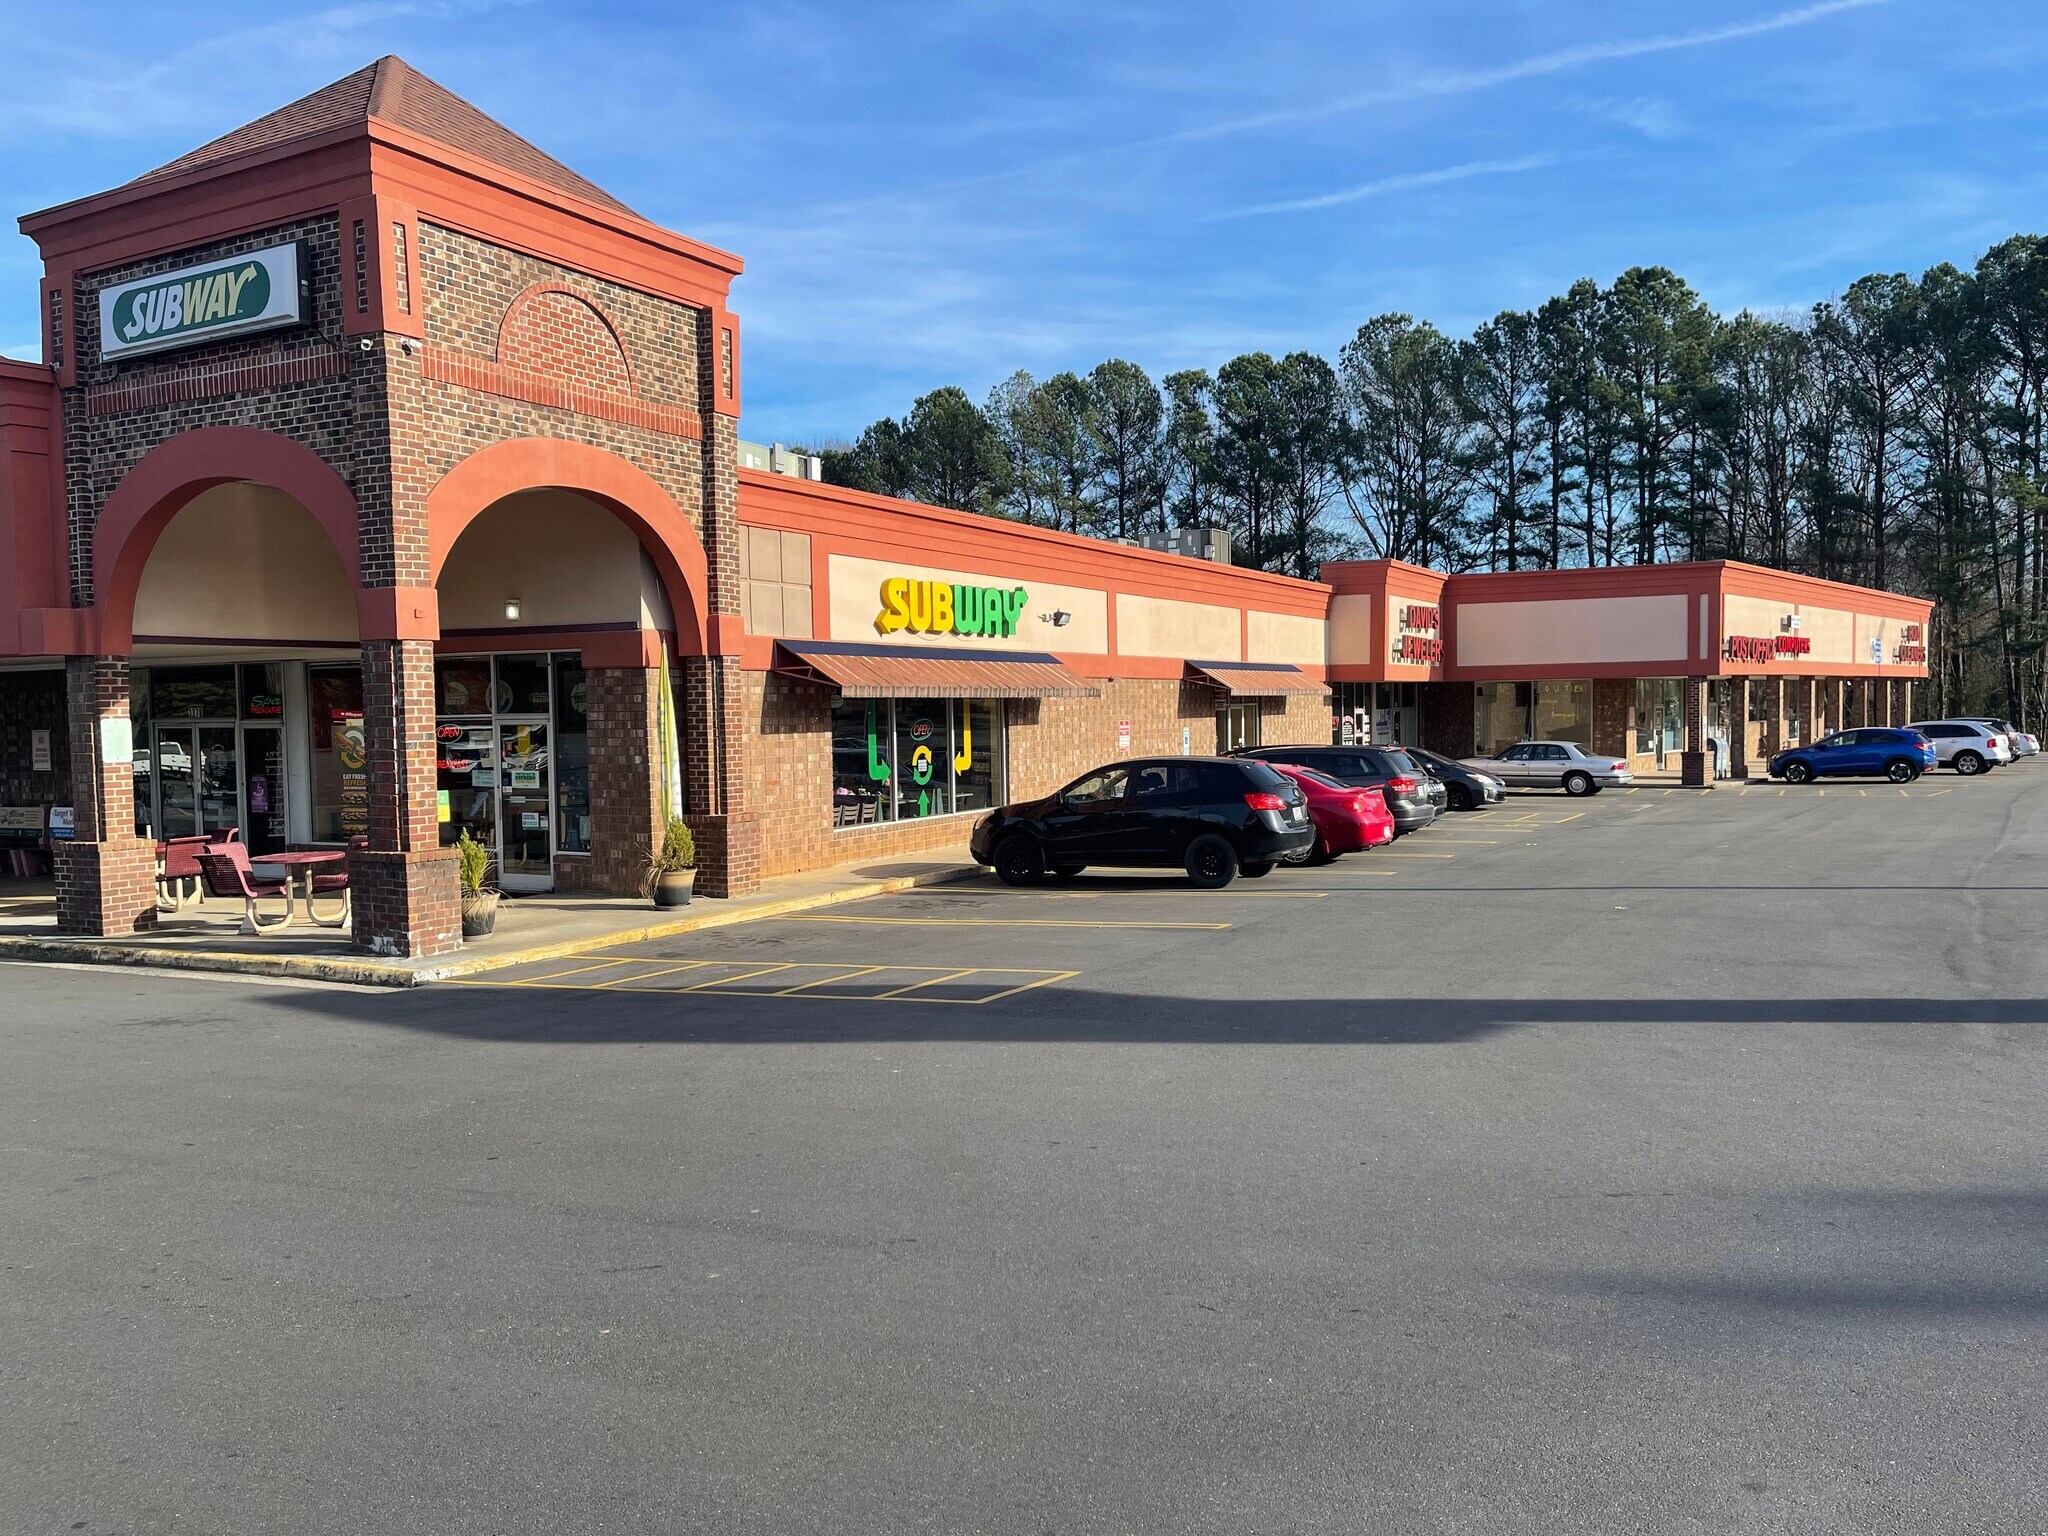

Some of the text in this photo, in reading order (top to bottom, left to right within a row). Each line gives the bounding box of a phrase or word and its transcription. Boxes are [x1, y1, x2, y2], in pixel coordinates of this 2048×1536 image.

[123, 263, 257, 341] SUBWAY
[873, 577, 1029, 637] SUBWAY
[1407, 605, 1440, 629] DAVID'S
[1402, 635, 1446, 662] JEWELERS
[1731, 636, 1777, 660] POST OFFICE
[1777, 635, 1810, 654] COMPUTERS
[1900, 645, 1926, 662] CLEANERS
[250, 695, 282, 707] Spa
[436, 726, 460, 739] OPEN
[913, 724, 930, 736] OPEN
